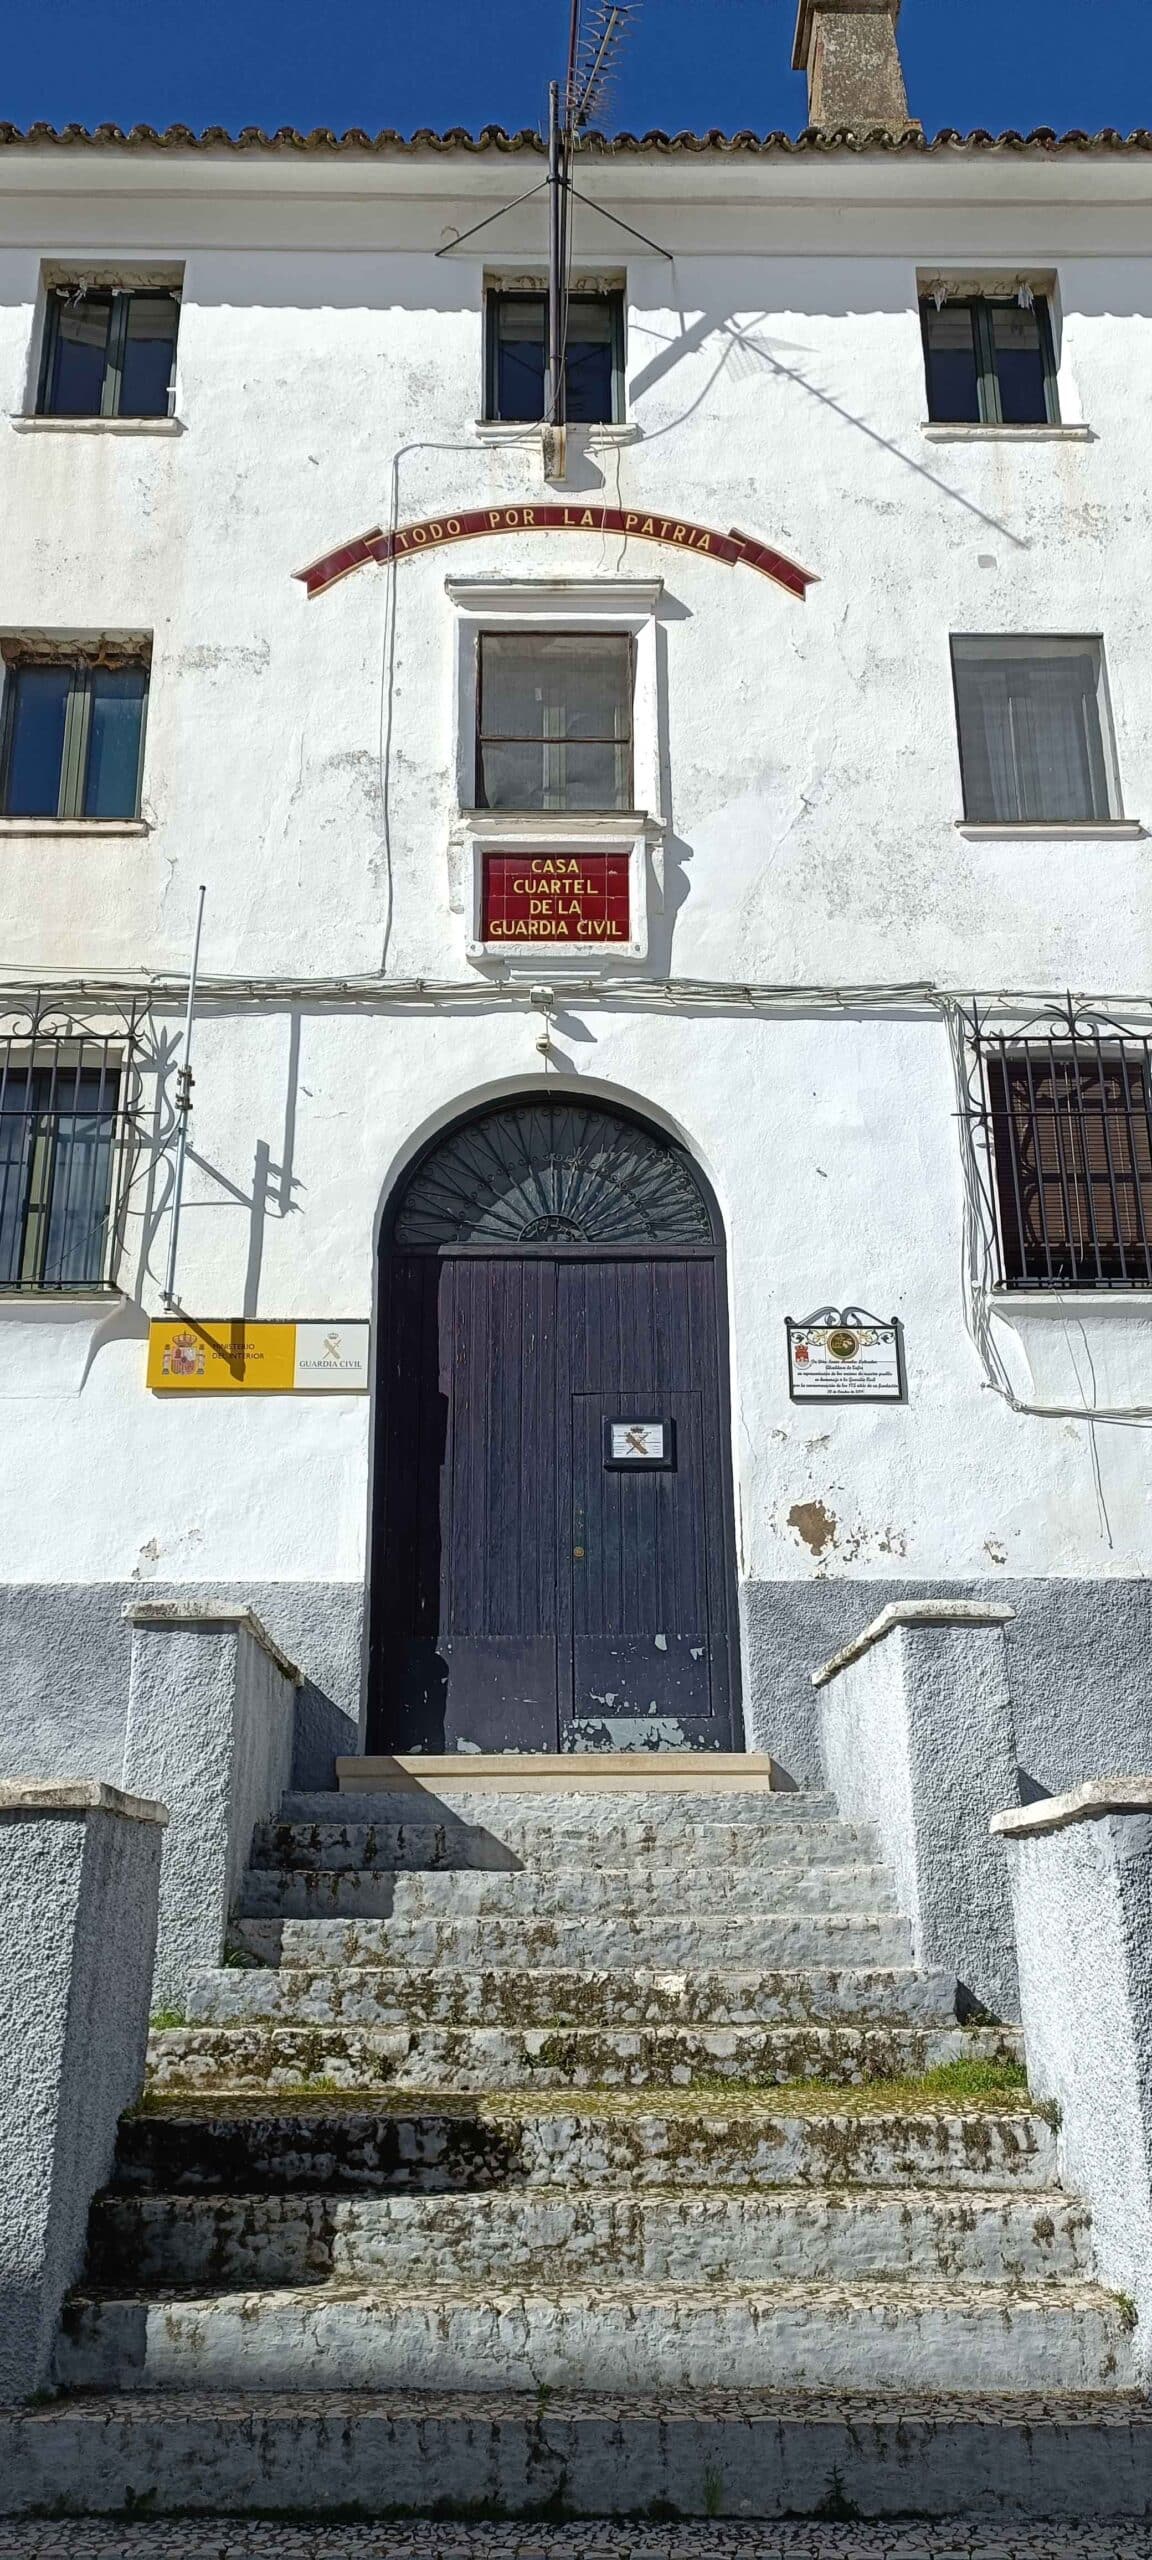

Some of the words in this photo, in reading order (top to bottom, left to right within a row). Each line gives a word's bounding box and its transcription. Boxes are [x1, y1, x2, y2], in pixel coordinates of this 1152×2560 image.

[396, 519, 461, 548] TODO
[488, 508, 535, 528] POR
[563, 508, 594, 526] LA
[625, 513, 711, 551] PATRIA
[531, 859, 579, 873] CASA
[513, 879, 599, 894] CUARTEL
[530, 900, 553, 914] DE
[558, 900, 582, 914] LA
[489, 920, 569, 935] GUARDIA
[576, 921, 623, 935] CIVIL
[299, 1360, 338, 1368] GUARDIA
[339, 1360, 363, 1368] CIVIL
